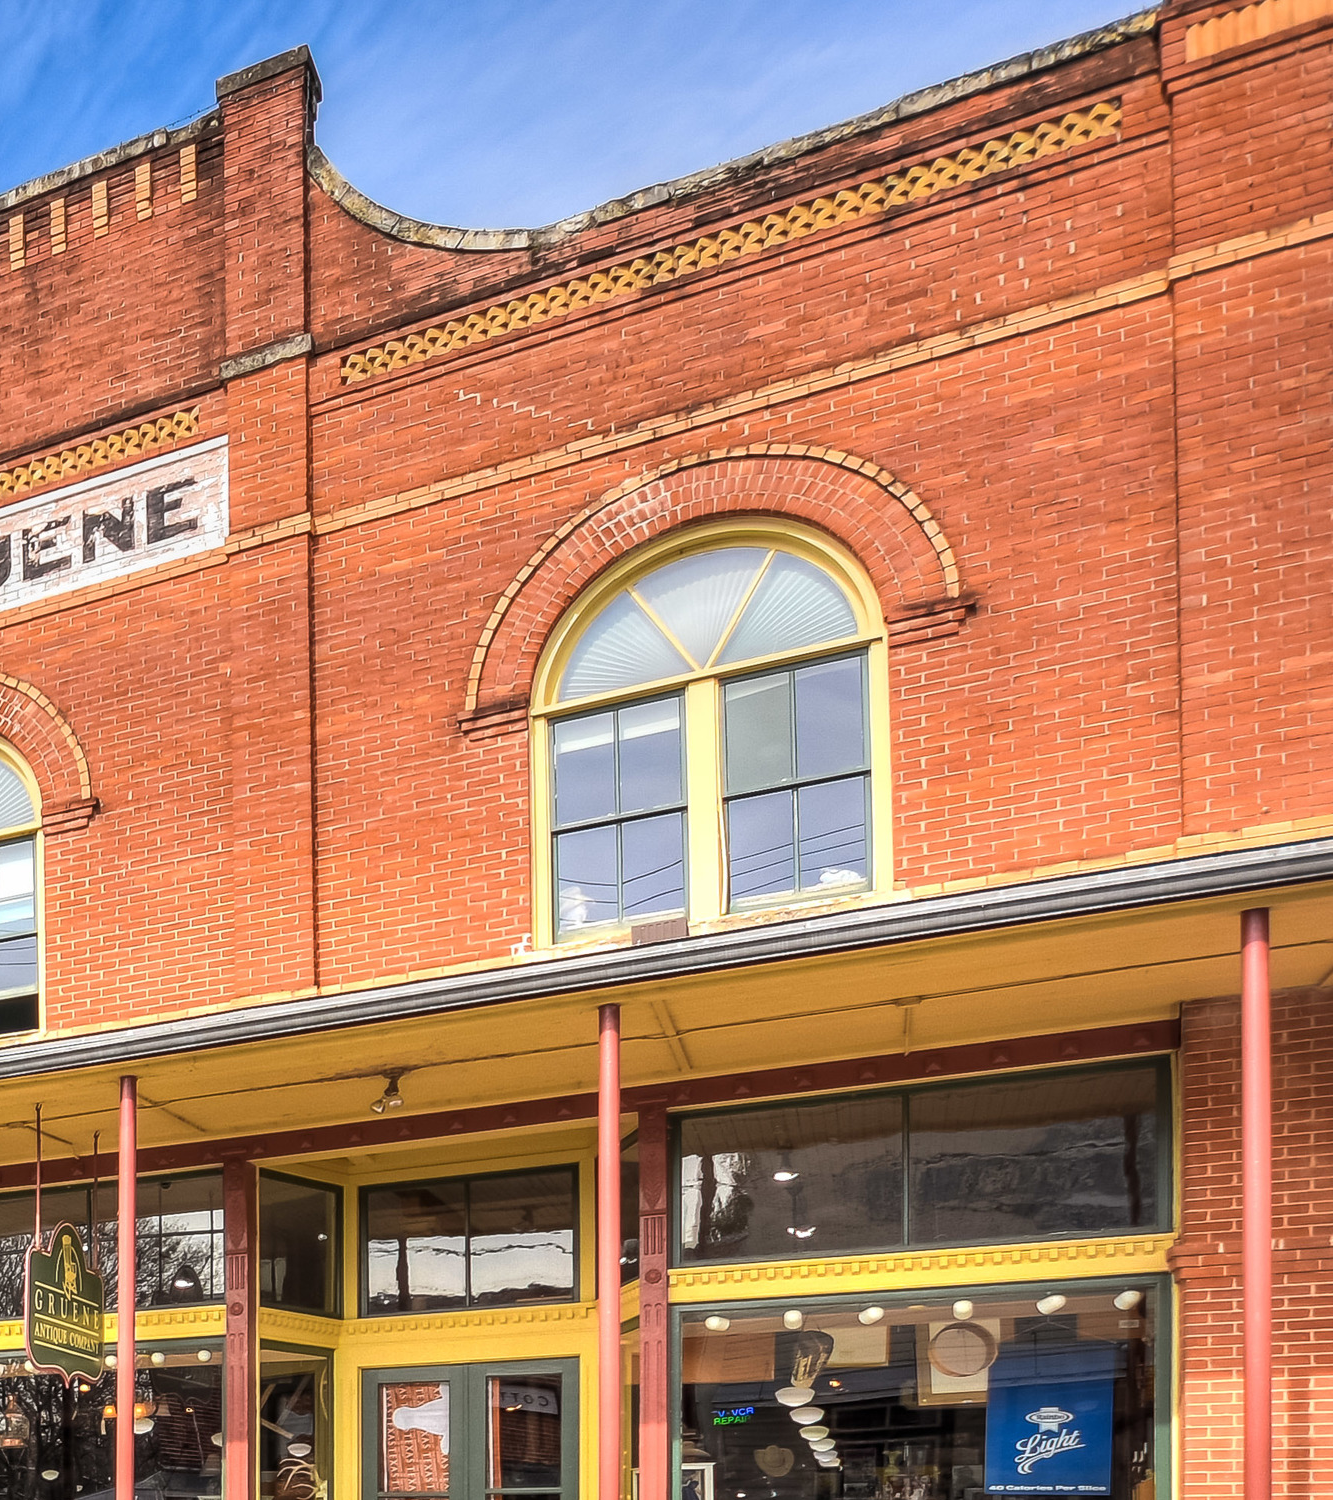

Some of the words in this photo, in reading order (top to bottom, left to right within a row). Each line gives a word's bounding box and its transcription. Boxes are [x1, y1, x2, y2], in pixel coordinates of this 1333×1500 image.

[34, 1288, 100, 1330] GRUENE
[34, 1321, 68, 1345] ANTIQUE
[69, 1332, 100, 1355] COMPANY
[1014, 1429, 1084, 1465] Light
